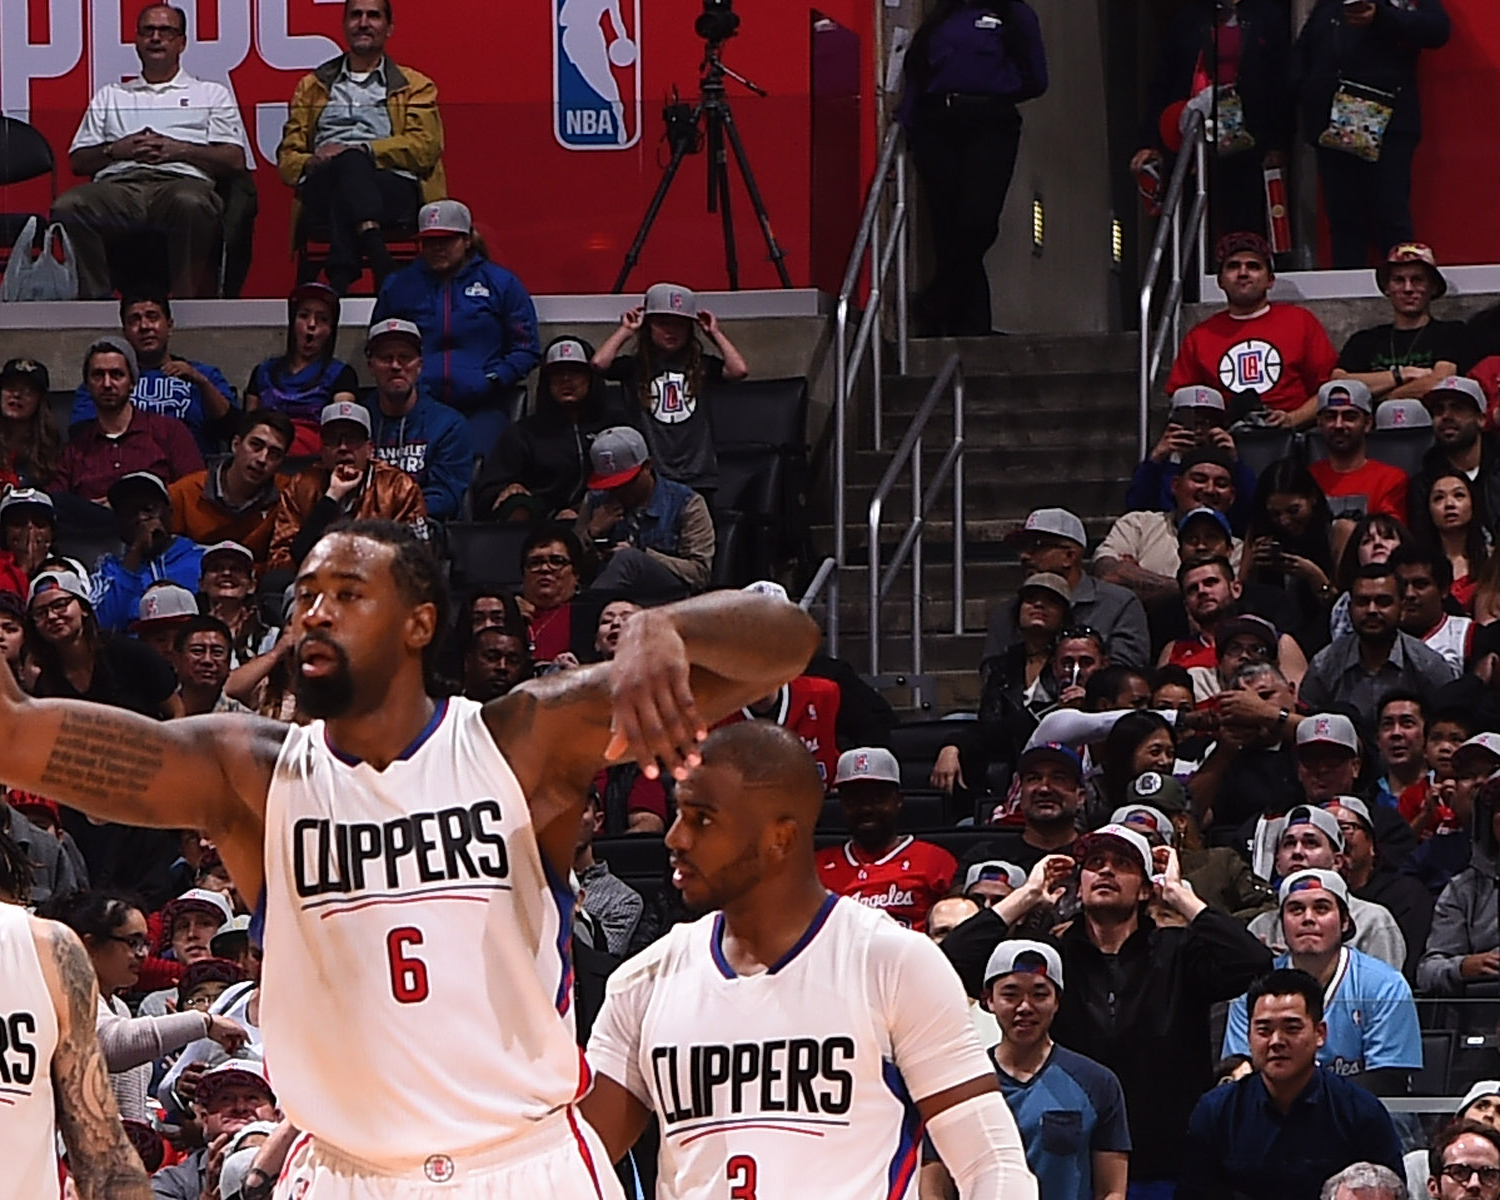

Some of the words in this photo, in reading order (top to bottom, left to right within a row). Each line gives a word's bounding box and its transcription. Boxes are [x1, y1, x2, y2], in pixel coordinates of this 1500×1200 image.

[566, 109, 614, 135] NBA
[294, 799, 510, 898] CLIPPERS
[386, 926, 430, 1004] 6
[651, 1036, 855, 1125] CLIPPERS
